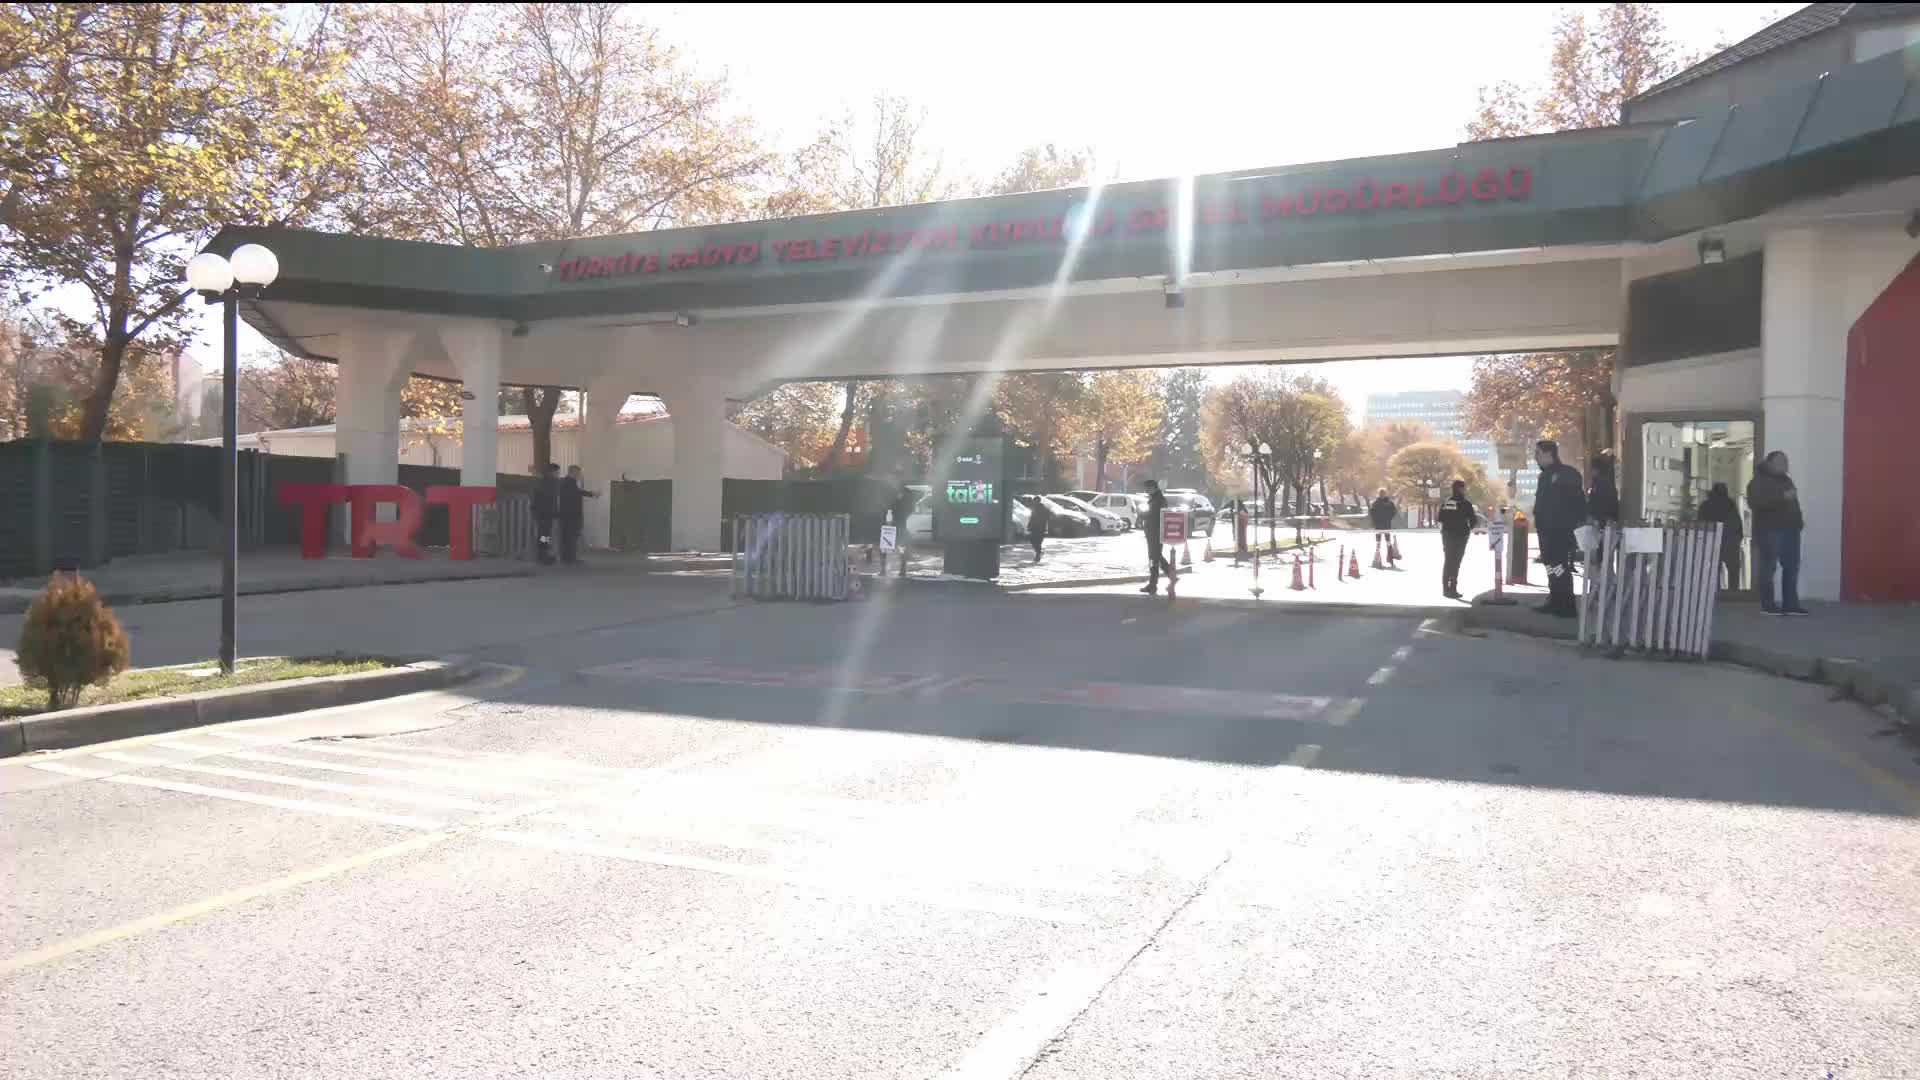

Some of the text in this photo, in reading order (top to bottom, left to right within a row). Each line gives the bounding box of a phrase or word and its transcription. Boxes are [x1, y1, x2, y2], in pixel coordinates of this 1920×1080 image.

[560, 251, 659, 282] TÜRKİYE
[666, 242, 760, 271] RADYO
[280, 483, 497, 560] TRT
